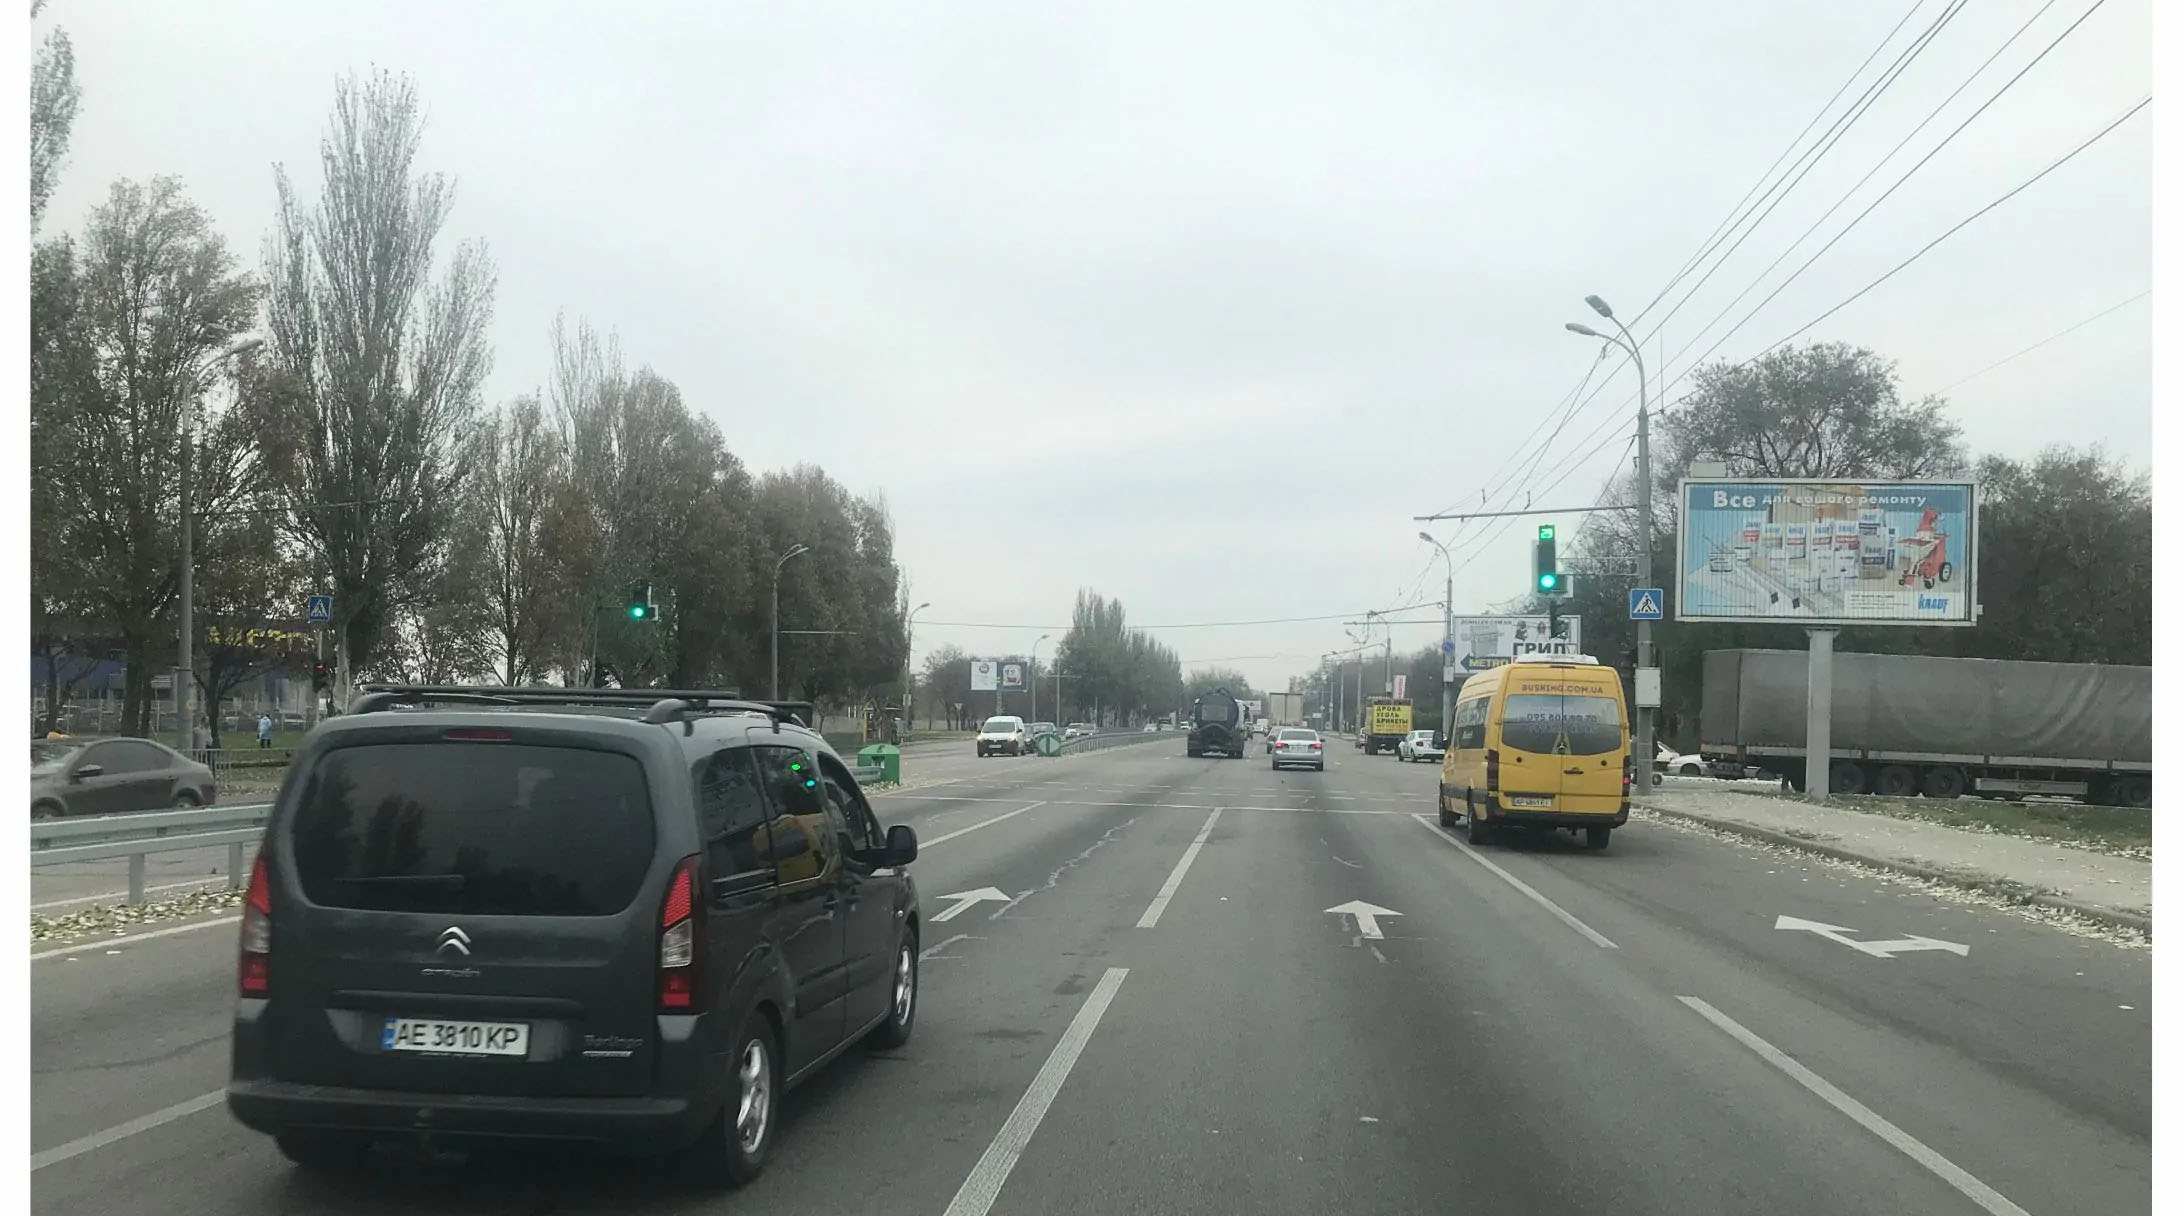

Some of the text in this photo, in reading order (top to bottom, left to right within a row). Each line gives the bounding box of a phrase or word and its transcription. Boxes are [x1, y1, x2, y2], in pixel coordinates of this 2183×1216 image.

[1713, 490, 1756, 508] Все
[1859, 495, 1927, 507] ремонту
[1918, 593, 1949, 613] KNAUF
[1469, 658, 1510, 668] METRO
[1526, 713, 1546, 722] 095
[396, 1023, 520, 1050] AE 3810 KP
